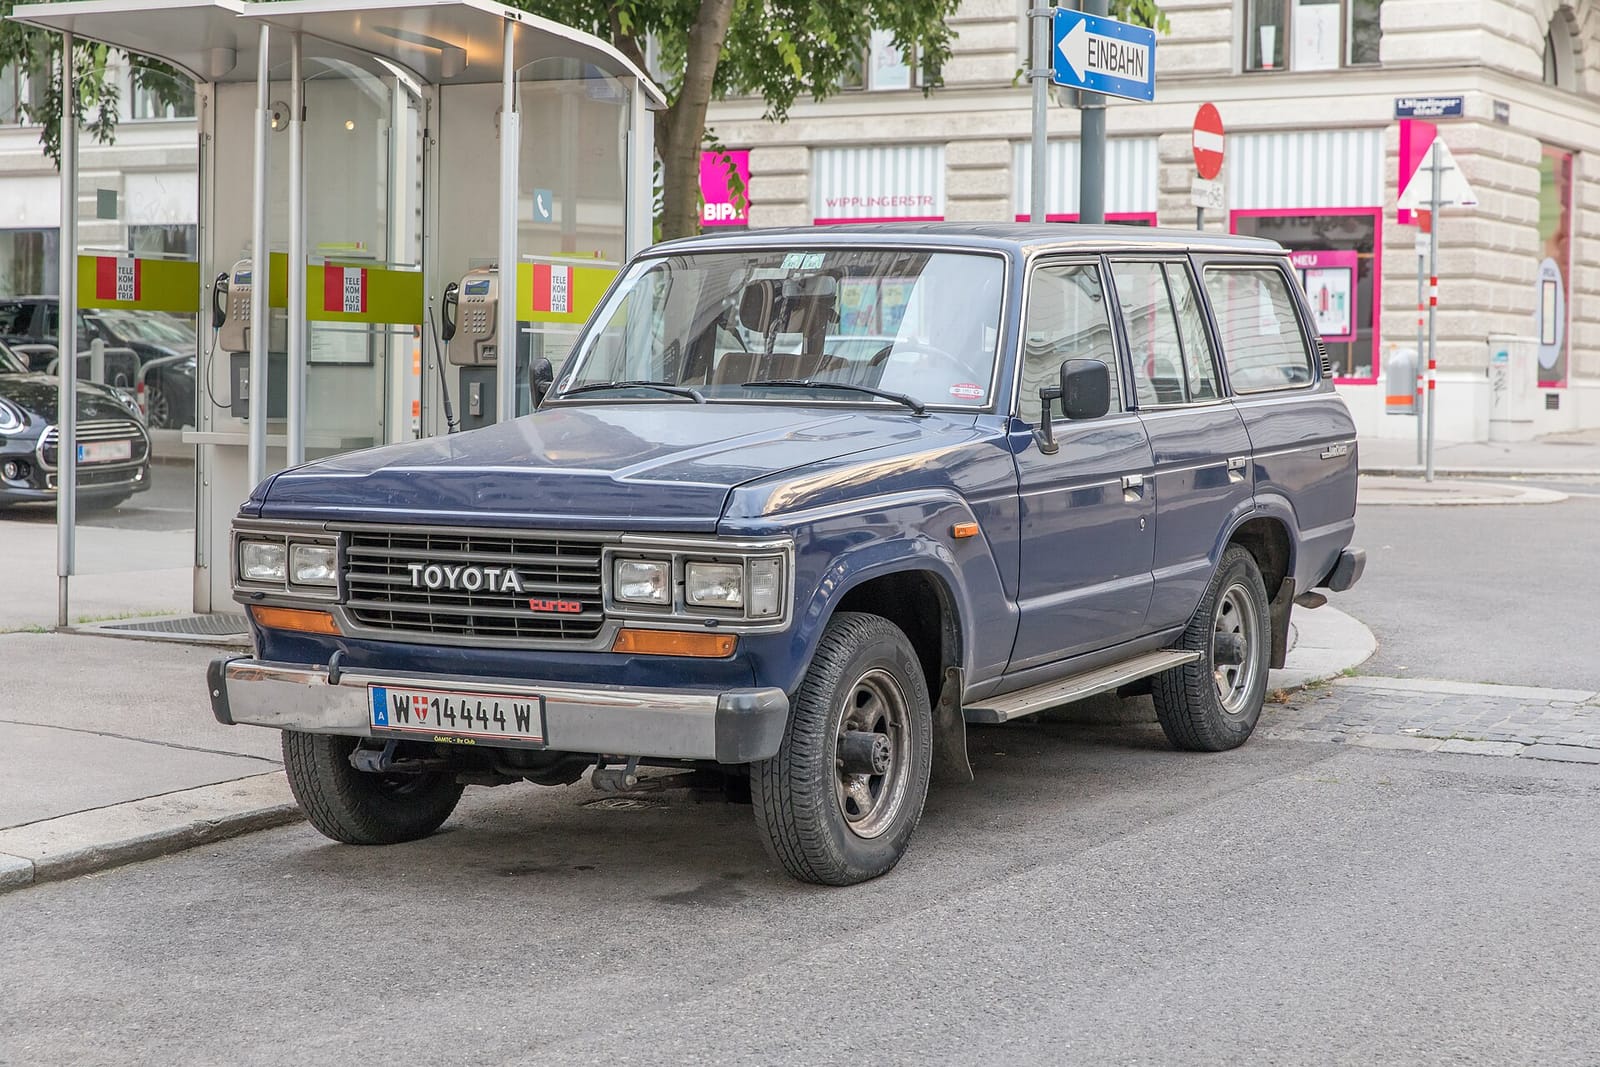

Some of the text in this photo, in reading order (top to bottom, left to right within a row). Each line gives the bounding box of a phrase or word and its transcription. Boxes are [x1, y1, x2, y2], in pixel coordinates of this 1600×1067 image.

[1088, 38, 1144, 77] EINBAHN
[1292, 254, 1318, 266] NEU
[118, 266, 134, 275] TELE
[118, 275, 134, 283] KOM
[345, 277, 360, 286] TELE
[552, 276, 566, 285] TELE
[118, 284, 134, 292] AUS
[345, 286, 360, 294] KOM
[552, 285, 566, 294] KOM
[118, 292, 134, 300] TRIA
[345, 295, 360, 303] AUS
[552, 294, 566, 303] AUS
[345, 303, 360, 312] TRIA
[552, 303, 566, 312] TRIA
[407, 564, 523, 593] TOYOTA
[529, 598, 582, 613] turbo
[378, 711, 385, 721] A
[393, 694, 531, 733] W 14444 W
